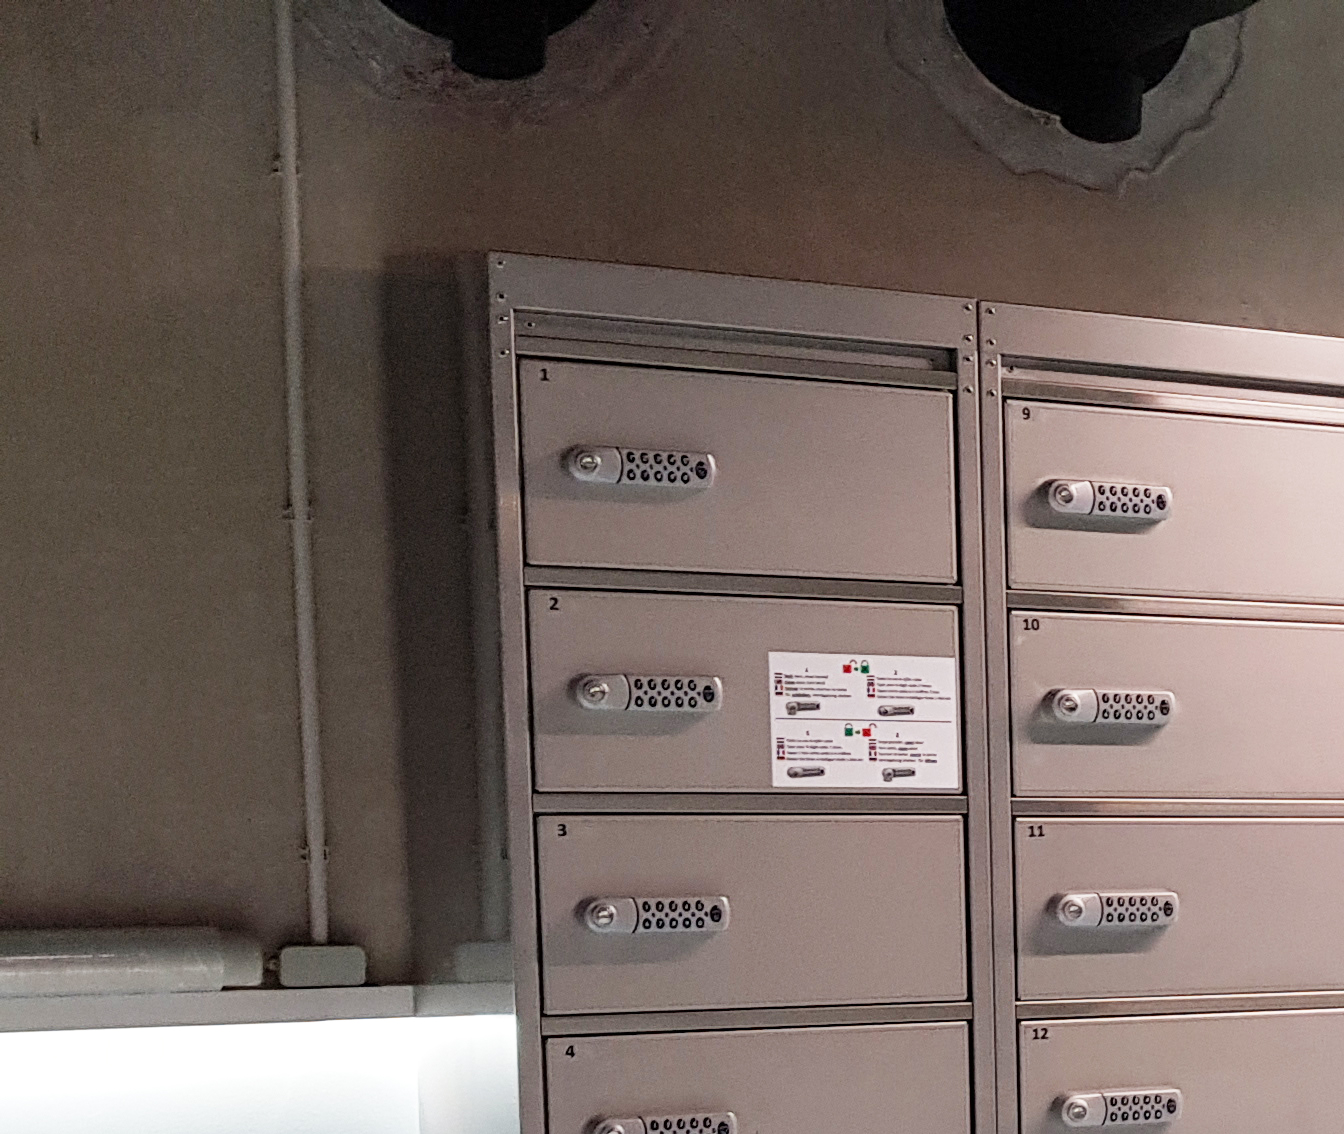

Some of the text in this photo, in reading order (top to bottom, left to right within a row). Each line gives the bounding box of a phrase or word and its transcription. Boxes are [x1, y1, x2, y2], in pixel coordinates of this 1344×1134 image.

[539, 368, 550, 382] 1
[1021, 406, 1031, 421] 9
[549, 596, 560, 611] 2
[1022, 618, 1040, 631] 10
[557, 823, 568, 837] 3
[1027, 824, 1046, 838] 11
[1032, 1027, 1049, 1041] 12
[564, 1044, 576, 1058] 4
